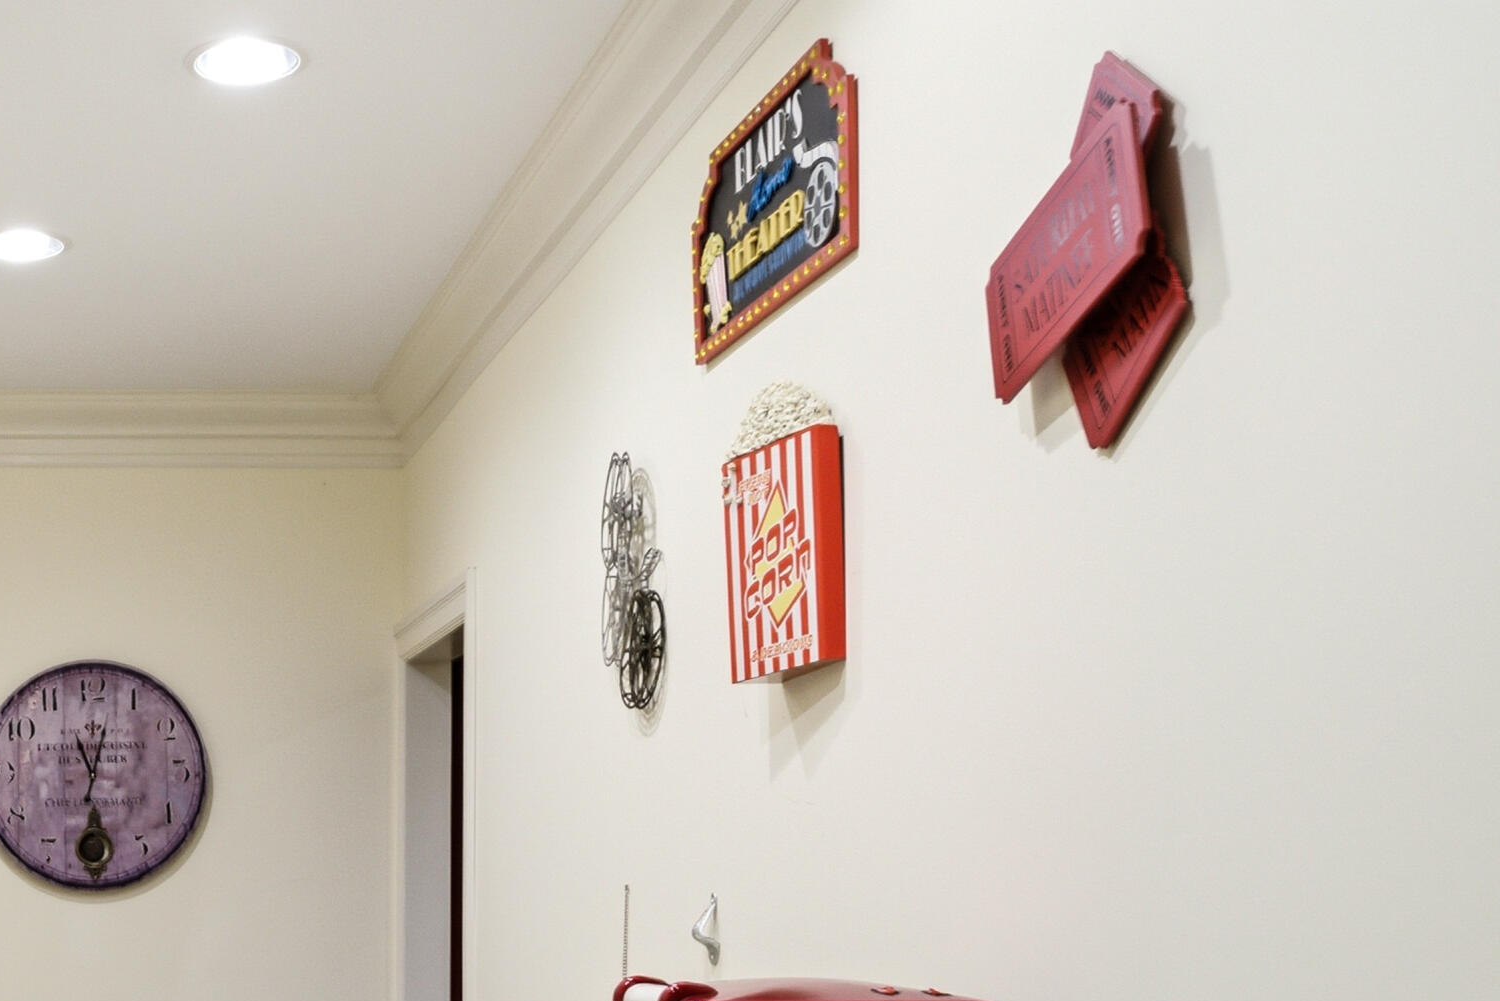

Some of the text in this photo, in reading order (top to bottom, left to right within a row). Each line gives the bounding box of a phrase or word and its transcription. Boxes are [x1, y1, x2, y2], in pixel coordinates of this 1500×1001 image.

[735, 89, 803, 195] BLAIR'S
[749, 508, 797, 577] POP
[745, 539, 811, 620] CORN
[42, 687, 58, 711] 11
[80, 677, 106, 703] 12
[130, 687, 136, 711] 1
[8, 718, 36, 742] 10
[156, 718, 176, 742] 2
